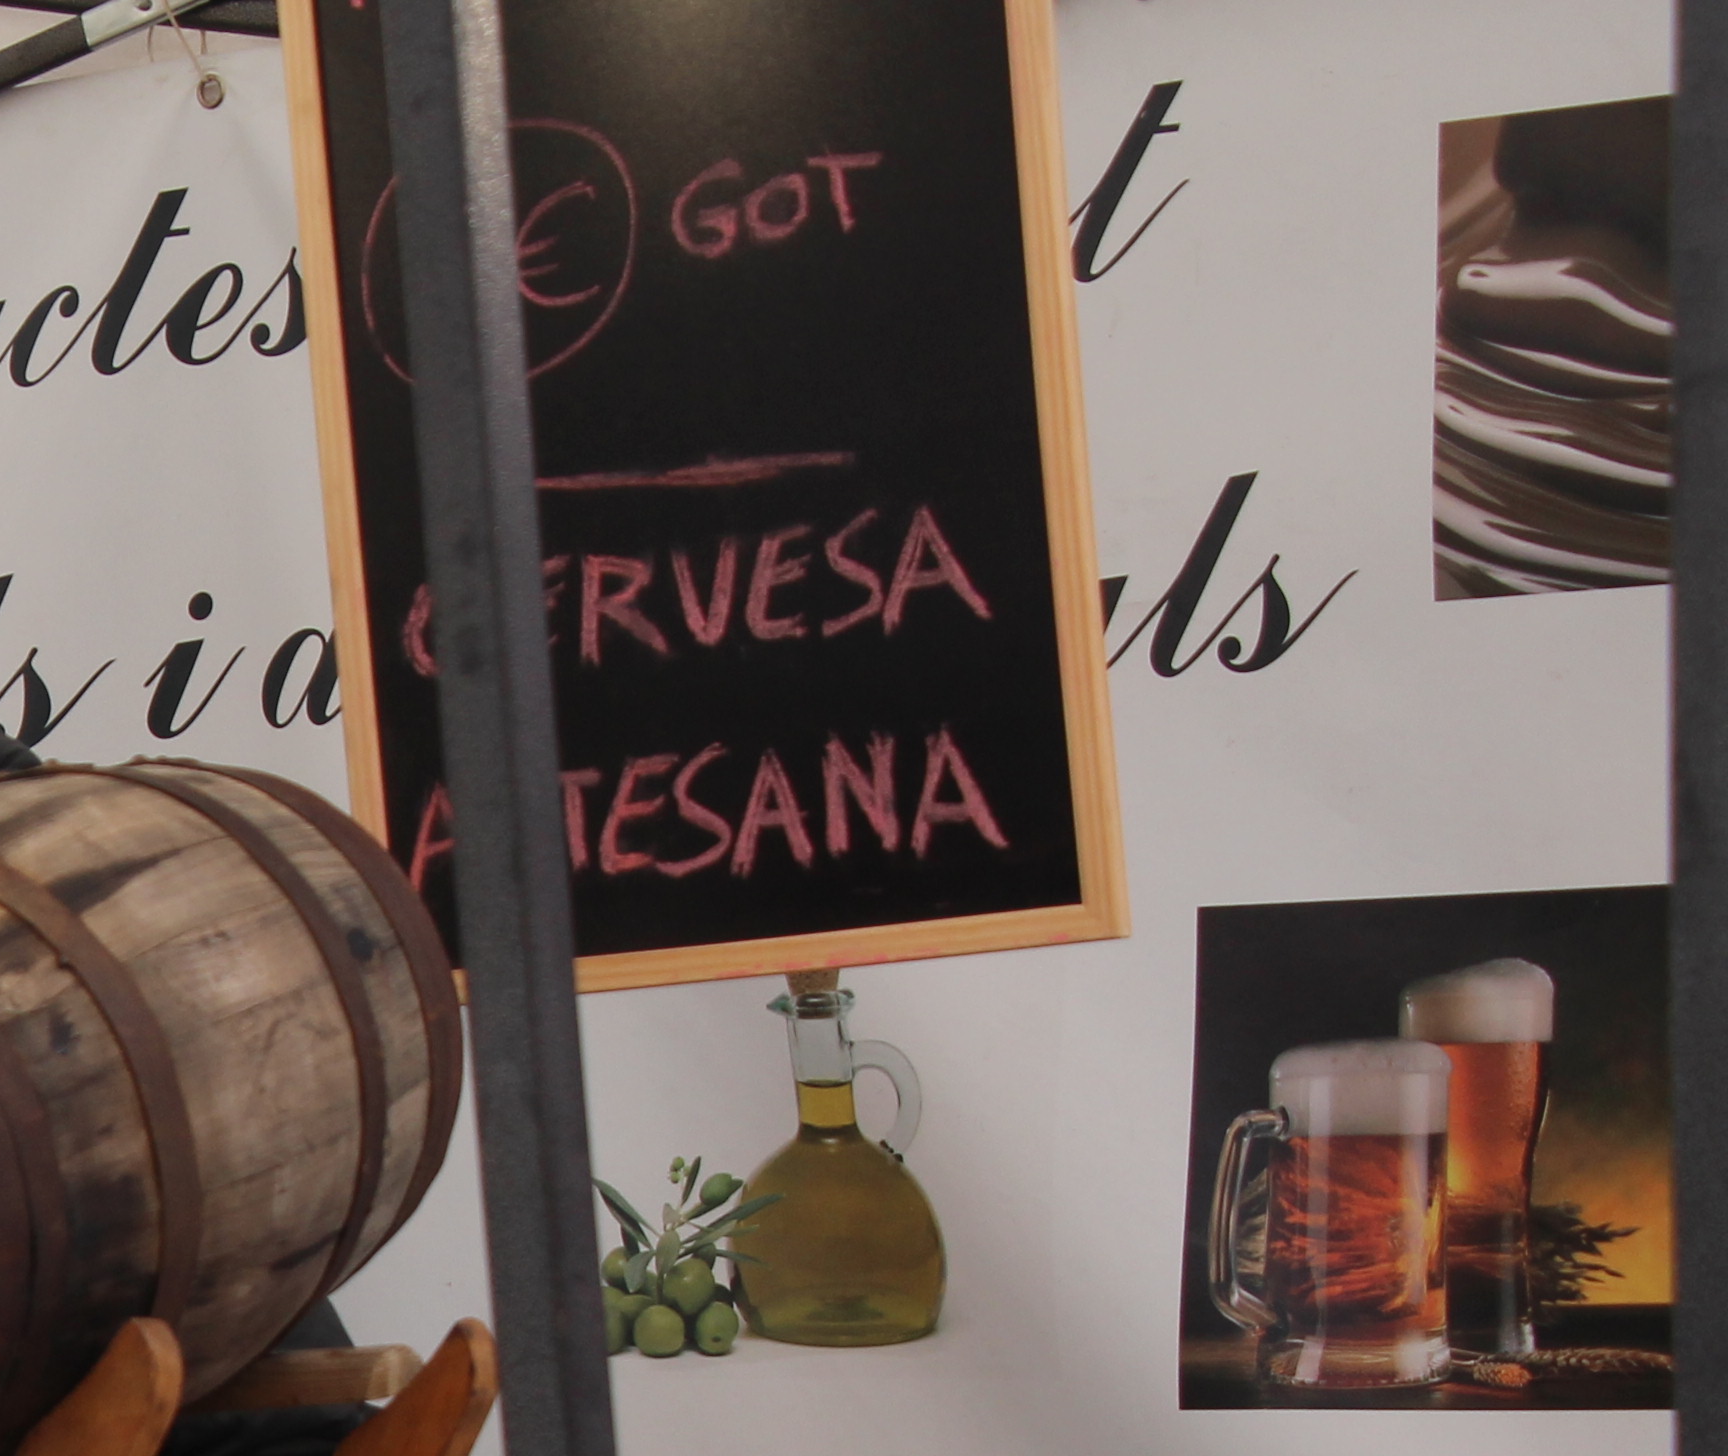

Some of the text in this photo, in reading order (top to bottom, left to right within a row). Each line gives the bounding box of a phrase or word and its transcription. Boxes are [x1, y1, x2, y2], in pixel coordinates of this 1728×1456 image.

[670, 150, 885, 260] GOT
[144, 590, 247, 740] i
[402, 502, 994, 678] CRVESA
[406, 722, 1010, 898] ATESANA
